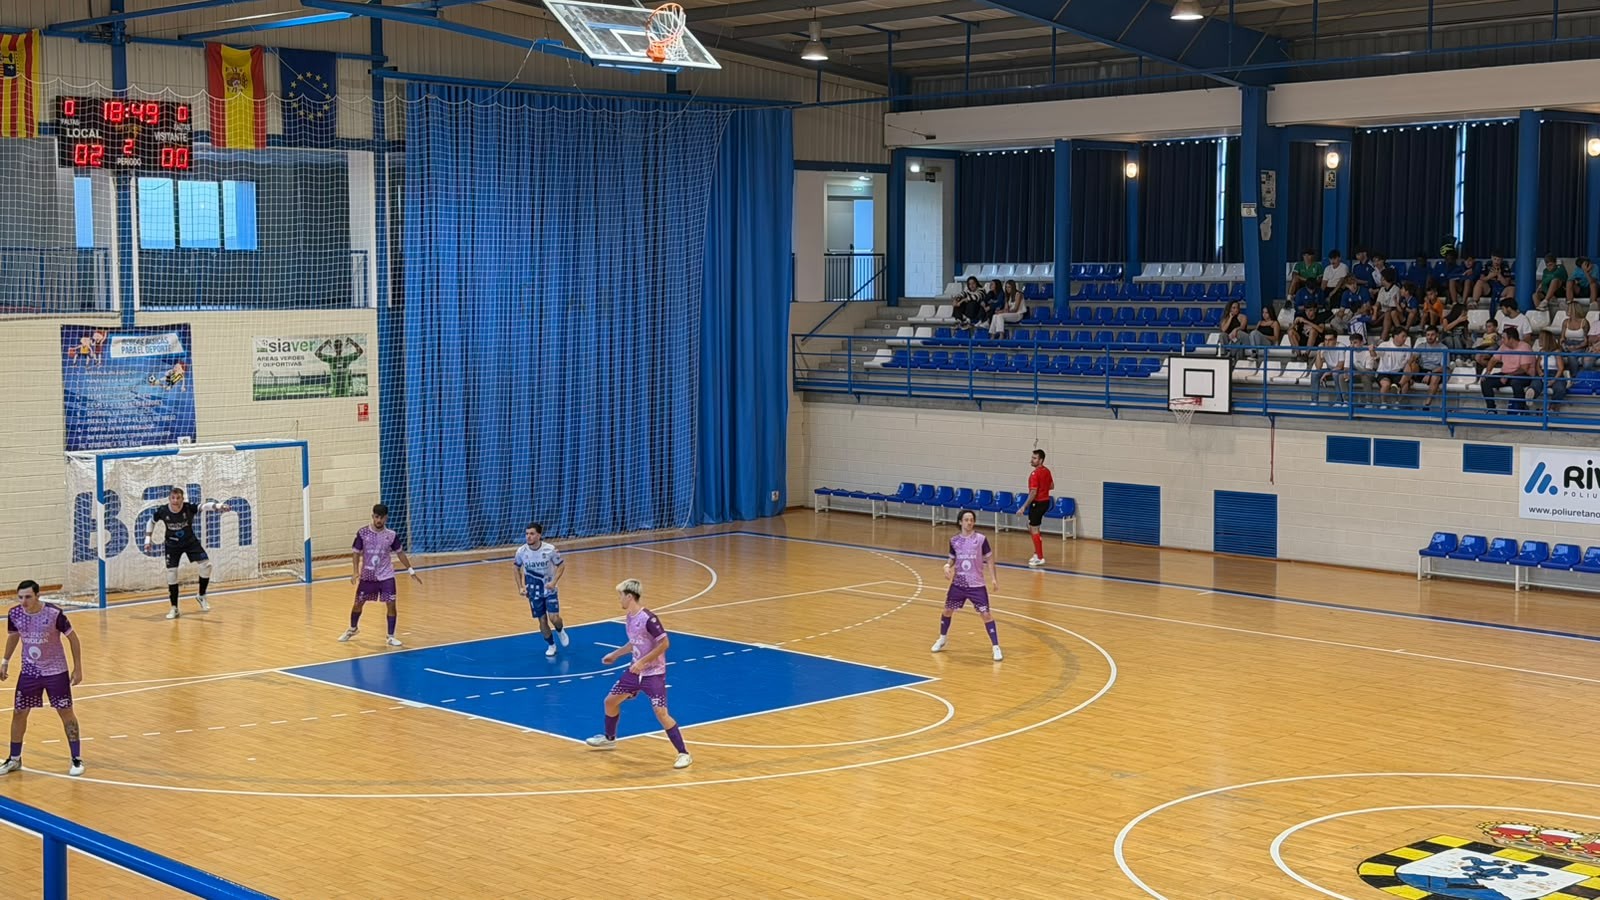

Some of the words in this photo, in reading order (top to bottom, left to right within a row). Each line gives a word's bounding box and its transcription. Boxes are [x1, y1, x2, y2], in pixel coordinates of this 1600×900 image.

[64, 100, 75, 116] 0
[104, 101, 159, 124] 18:49
[177, 106, 188, 122] 0
[66, 128, 102, 138] LOCAL
[154, 132, 188, 141] VISITANTE
[123, 139, 134, 155] 2
[75, 144, 104, 166] 02
[162, 148, 188, 168] 00
[121, 346, 136, 354] PARA
[145, 345, 172, 353] DEPORTE
[268, 338, 316, 353] siaver
[1563, 491, 1598, 499] POLIU
[525, 560, 549, 568] siaver
